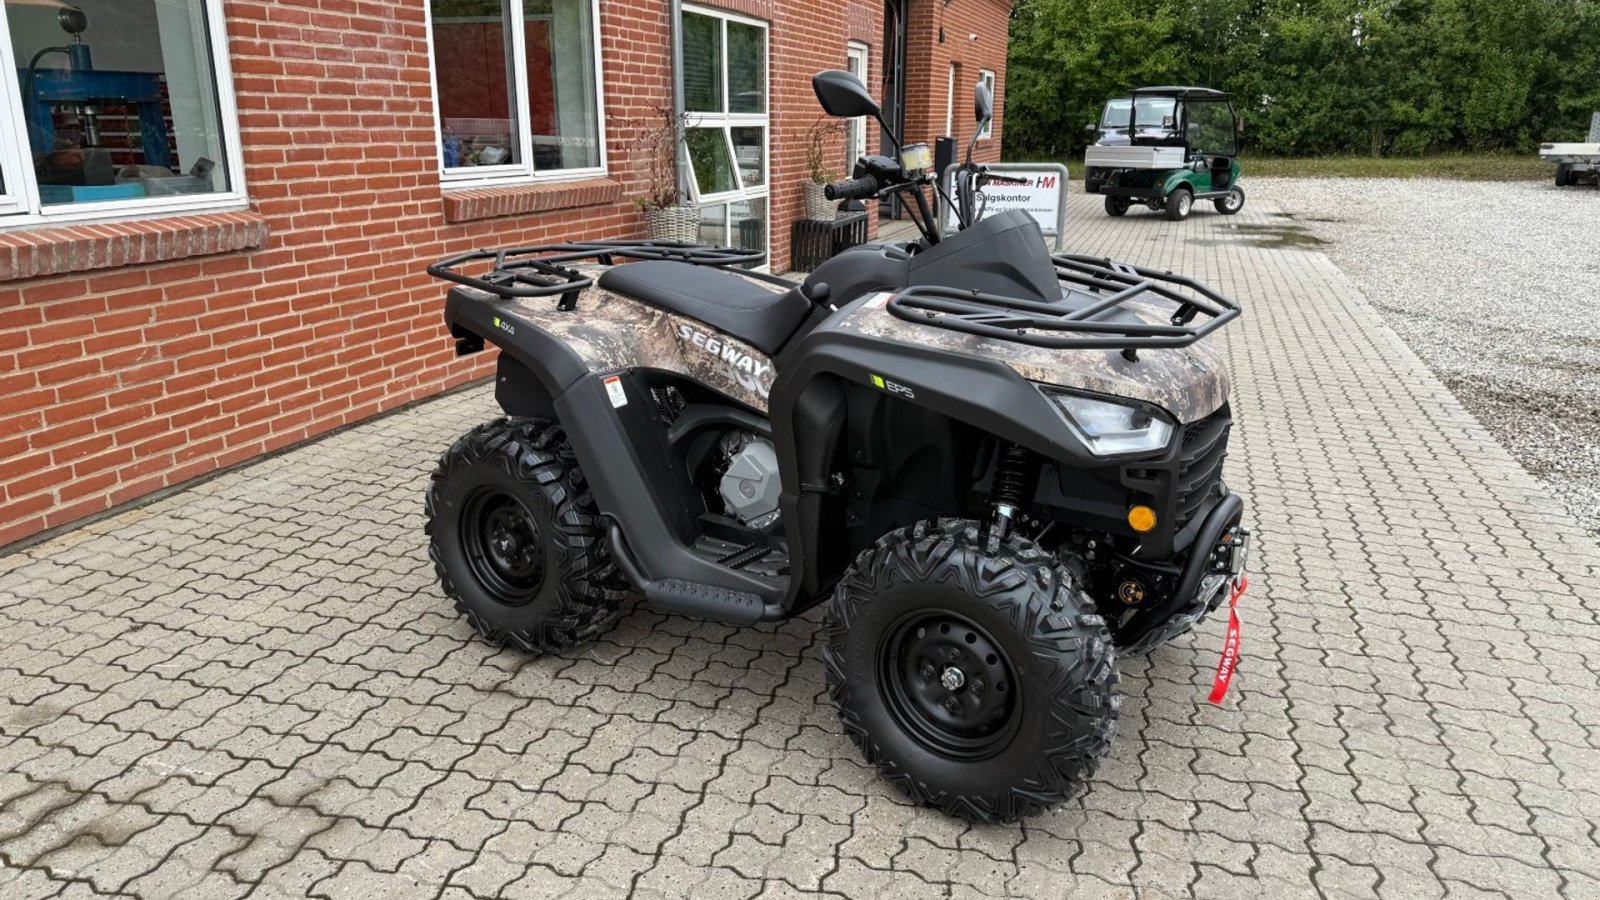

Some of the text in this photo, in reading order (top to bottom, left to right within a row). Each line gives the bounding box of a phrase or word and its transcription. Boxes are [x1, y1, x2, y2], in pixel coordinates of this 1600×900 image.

[678, 324, 771, 377] SEGWAY
[885, 380, 914, 398] EPS
[1219, 629, 1236, 683] SEGWAY
